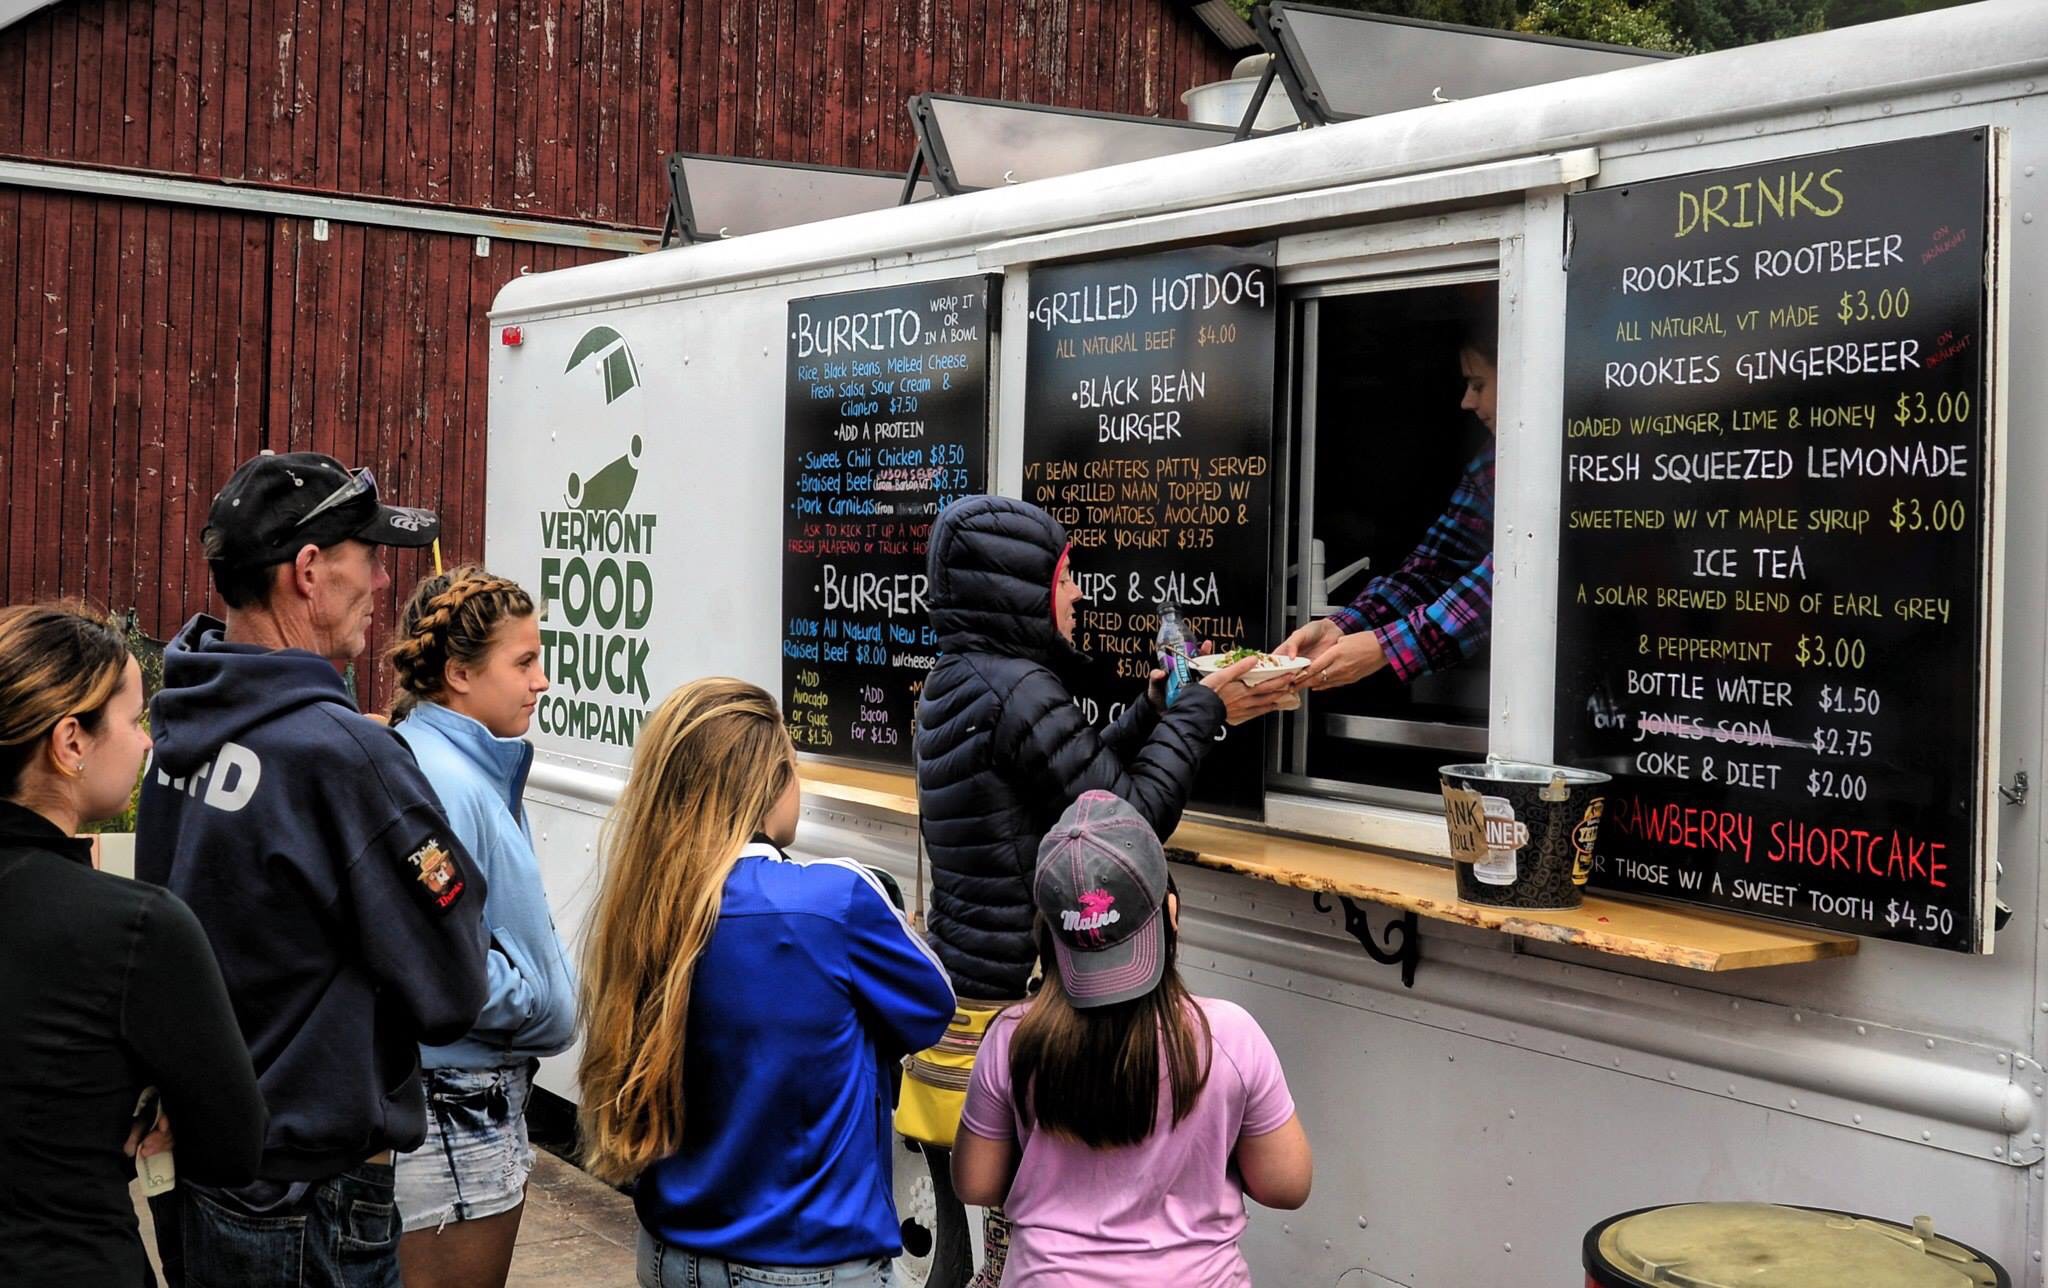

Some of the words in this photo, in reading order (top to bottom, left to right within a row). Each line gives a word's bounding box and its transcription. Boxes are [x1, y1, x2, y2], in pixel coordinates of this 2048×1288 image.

[1674, 168, 1844, 239] DRINKS
[1622, 255, 1740, 295] ROOKIES
[1755, 234, 1904, 280] ROOTBEER
[929, 296, 958, 313] WRAP
[962, 294, 975, 309] IT
[1036, 283, 1138, 331] GRILLED
[1152, 268, 1265, 314] HOTDOG
[944, 312, 959, 327] OR
[1615, 319, 1643, 343] ALL
[1650, 311, 1728, 339] NATURAL,
[1736, 309, 1760, 332] VT
[1769, 304, 1820, 330] MADE
[1836, 287, 1911, 327] $3.00
[798, 308, 921, 358] BURRITO
[924, 331, 937, 345] IN
[940, 330, 947, 343] A
[951, 326, 978, 343] BOWL
[1056, 339, 1076, 360] ALL
[1082, 332, 1138, 355] NATURAL
[1145, 328, 1177, 350] BEEF
[1198, 323, 1236, 348] $4.00
[824, 362, 848, 380] Black
[888, 355, 923, 375] Melted
[1605, 355, 1721, 389] ROOKIES
[1735, 339, 1921, 385] GINGERBEER
[811, 383, 835, 399] Fresh
[870, 380, 895, 396] Sour
[900, 377, 931, 392] Cream
[942, 372, 952, 390] &
[1079, 375, 1140, 409] BLACK
[1151, 369, 1205, 404] BEAN
[840, 401, 879, 417] Cilantro
[889, 396, 918, 415] $7.50
[1567, 416, 1621, 439] LOADED
[1732, 408, 1778, 431] LIME
[1788, 407, 1803, 430] &
[1809, 404, 1876, 429] HONEY
[1893, 391, 1970, 428] $3.00
[839, 423, 858, 441] ADD
[863, 422, 870, 440] A
[875, 420, 924, 443] PROTEIN
[1098, 410, 1182, 444] BURGER
[805, 451, 842, 470] Sweet
[847, 450, 871, 467] Chili
[878, 446, 923, 467] Chicken
[930, 444, 965, 467] $8.50
[1023, 463, 1040, 481] VT
[1046, 460, 1078, 481] BEAN
[1083, 457, 1150, 480] CRAFTERS
[1156, 456, 1202, 481] PATTY,
[1208, 455, 1267, 477] SERVED
[1568, 453, 1640, 483] FRESH
[1652, 449, 1794, 484] SQUEEZED
[1807, 441, 1968, 479] LEMONADE
[801, 473, 841, 494] Braised
[846, 468, 875, 492] Beef
[932, 469, 968, 491] $8.75
[1036, 485, 1056, 502] ON
[1062, 481, 1116, 502] GRILLED
[1167, 481, 1222, 504] TOPPED
[1229, 480, 1251, 500] W/
[797, 496, 822, 519] Pork
[828, 495, 875, 516] Carnitas
[1164, 504, 1230, 525] AVOCADO
[1237, 503, 1249, 525] &
[1568, 509, 1665, 530] SWEETENED
[1673, 508, 1698, 531] W/
[1706, 508, 1729, 530] VT
[1738, 507, 1799, 534] MAPLE
[1807, 508, 1870, 536] SYRUP
[1889, 497, 1966, 534] $3.00
[540, 511, 657, 555] VERMONT
[803, 524, 821, 537] ASK
[825, 524, 837, 537] TO
[840, 523, 862, 538] KICK
[866, 523, 877, 538] IT
[882, 524, 894, 538] UP
[899, 524, 905, 537] A
[1114, 528, 1170, 550] YOGURT
[1177, 528, 1214, 550] $9.75
[788, 539, 815, 554] FRESH
[864, 543, 874, 554] or
[879, 541, 909, 555] TRUCK
[1692, 548, 1738, 578] ICE
[1753, 545, 1807, 581] TEA
[540, 557, 653, 630] FOOD
[1128, 571, 1144, 603] &
[1151, 570, 1220, 607] SALSA
[1577, 583, 1588, 605] A
[1595, 585, 1648, 608] SOLAR
[1657, 588, 1727, 612] BREWED
[1735, 589, 1790, 613] BLEND
[1800, 591, 1824, 615] OF
[1833, 594, 1883, 619] EARL
[1895, 597, 1950, 625] GREY
[789, 617, 819, 637] 100%
[823, 617, 837, 638] All
[889, 623, 915, 644] New
[1083, 610, 1122, 632] FRIED
[783, 640, 819, 662] Raised
[824, 641, 850, 662] Beef
[856, 645, 887, 665] $8.00
[1083, 632, 1092, 651] &
[1098, 634, 1142, 655] TRUCK
[1638, 633, 1652, 656] &
[1658, 636, 1772, 663] PEPPERMINT
[1795, 634, 1866, 670] $3.00
[540, 629, 650, 705] TRUCK
[801, 669, 820, 687] ADD
[1117, 658, 1150, 678] $5.00
[793, 688, 829, 710] Avocado
[864, 684, 884, 704] ADD
[1628, 669, 1704, 701] BOTTLE
[1716, 675, 1794, 708] WATER
[1818, 684, 1880, 716] $1.50
[792, 709, 803, 721] or
[807, 710, 829, 726] Guac
[860, 705, 888, 724] Bacon
[807, 727, 833, 747] $1.50
[851, 722, 866, 741] for
[871, 727, 898, 745] $1.50
[1632, 711, 1704, 742] JONES
[1717, 718, 1777, 748] SODA
[1811, 726, 1873, 758] $2.75
[1636, 751, 1691, 781] COKE
[1701, 757, 1718, 782] &
[1727, 761, 1782, 791] DIET
[1807, 768, 1868, 801] $2.00
[1768, 820, 1949, 889] SHORTCAKE
[1615, 857, 1669, 885] THOSE
[1678, 869, 1703, 891] W/
[1711, 872, 1724, 895] A
[1732, 880, 1799, 908] SWEET
[1808, 890, 1874, 922] TOOTH
[1885, 902, 1953, 935] $4.50
[1060, 909, 1121, 932] Maine
